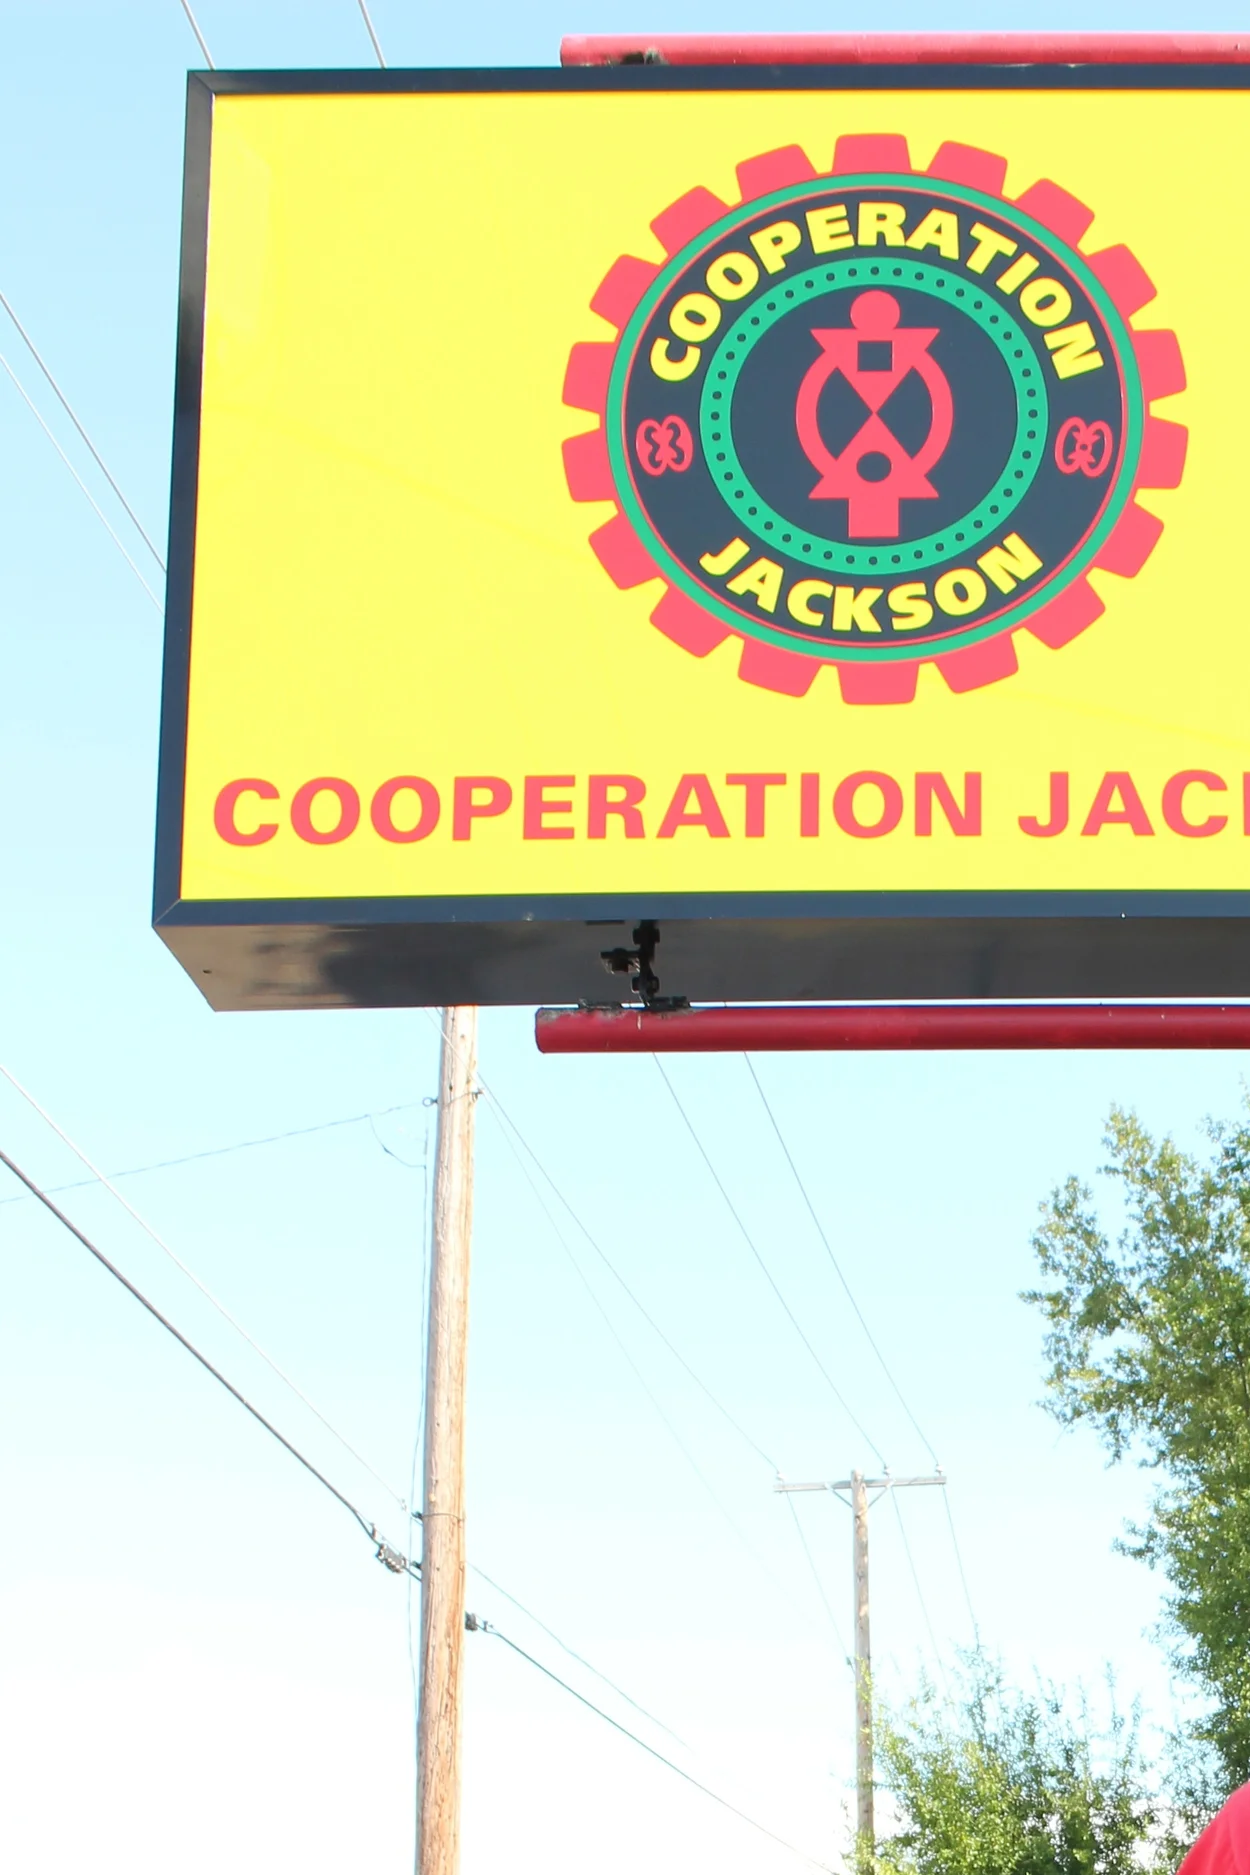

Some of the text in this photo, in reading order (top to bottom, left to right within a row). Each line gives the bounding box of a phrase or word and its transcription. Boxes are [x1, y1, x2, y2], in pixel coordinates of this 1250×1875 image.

[650, 201, 1104, 382] COOPERATION
[698, 531, 1044, 633] JACKSON
[213, 770, 982, 847] COOPERATION
